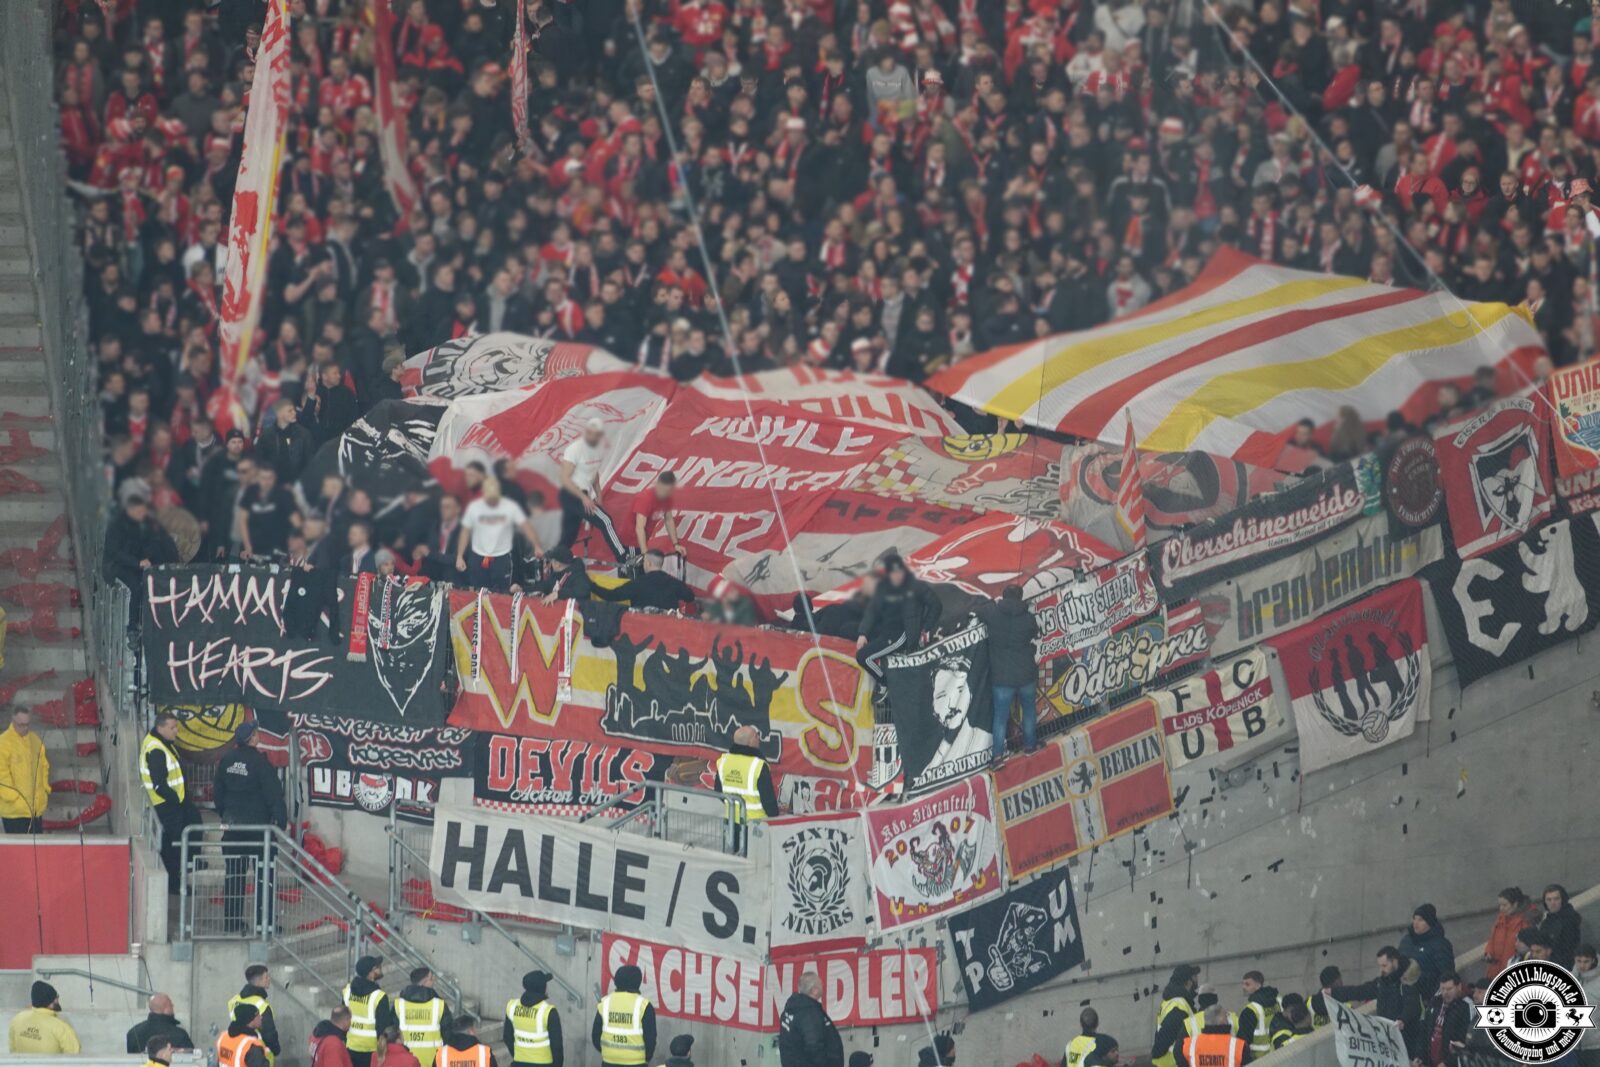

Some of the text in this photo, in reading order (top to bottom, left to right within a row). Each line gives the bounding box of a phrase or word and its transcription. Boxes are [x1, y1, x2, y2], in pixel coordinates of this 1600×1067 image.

[1162, 482, 1359, 574] Oberschöneweide
[148, 573, 290, 637] HAMM
[1057, 591, 1097, 634] FÜNF
[1095, 568, 1138, 613] SIEBEN
[167, 637, 335, 704] HEARTS
[1062, 650, 1130, 705] Oder
[1130, 623, 1208, 682] Spree
[1232, 658, 1255, 690] C
[1171, 688, 1264, 732] LADS KÖPENICK
[1180, 704, 1266, 760] U B
[487, 734, 656, 806] DEVILS
[1001, 773, 1066, 823] EISERN
[1099, 733, 1162, 782] BERLIN
[510, 784, 574, 804] Action
[781, 826, 856, 854] SIXTY
[441, 821, 652, 921] HALLE
[1047, 879, 1068, 920] U
[781, 907, 855, 936] NINERS
[1053, 921, 1076, 953] M
[513, 1005, 537, 1020] SECURITY
[608, 1011, 634, 1025] SECURITY
[409, 1031, 425, 1042] 1057
[612, 1035, 628, 1043] 1383
